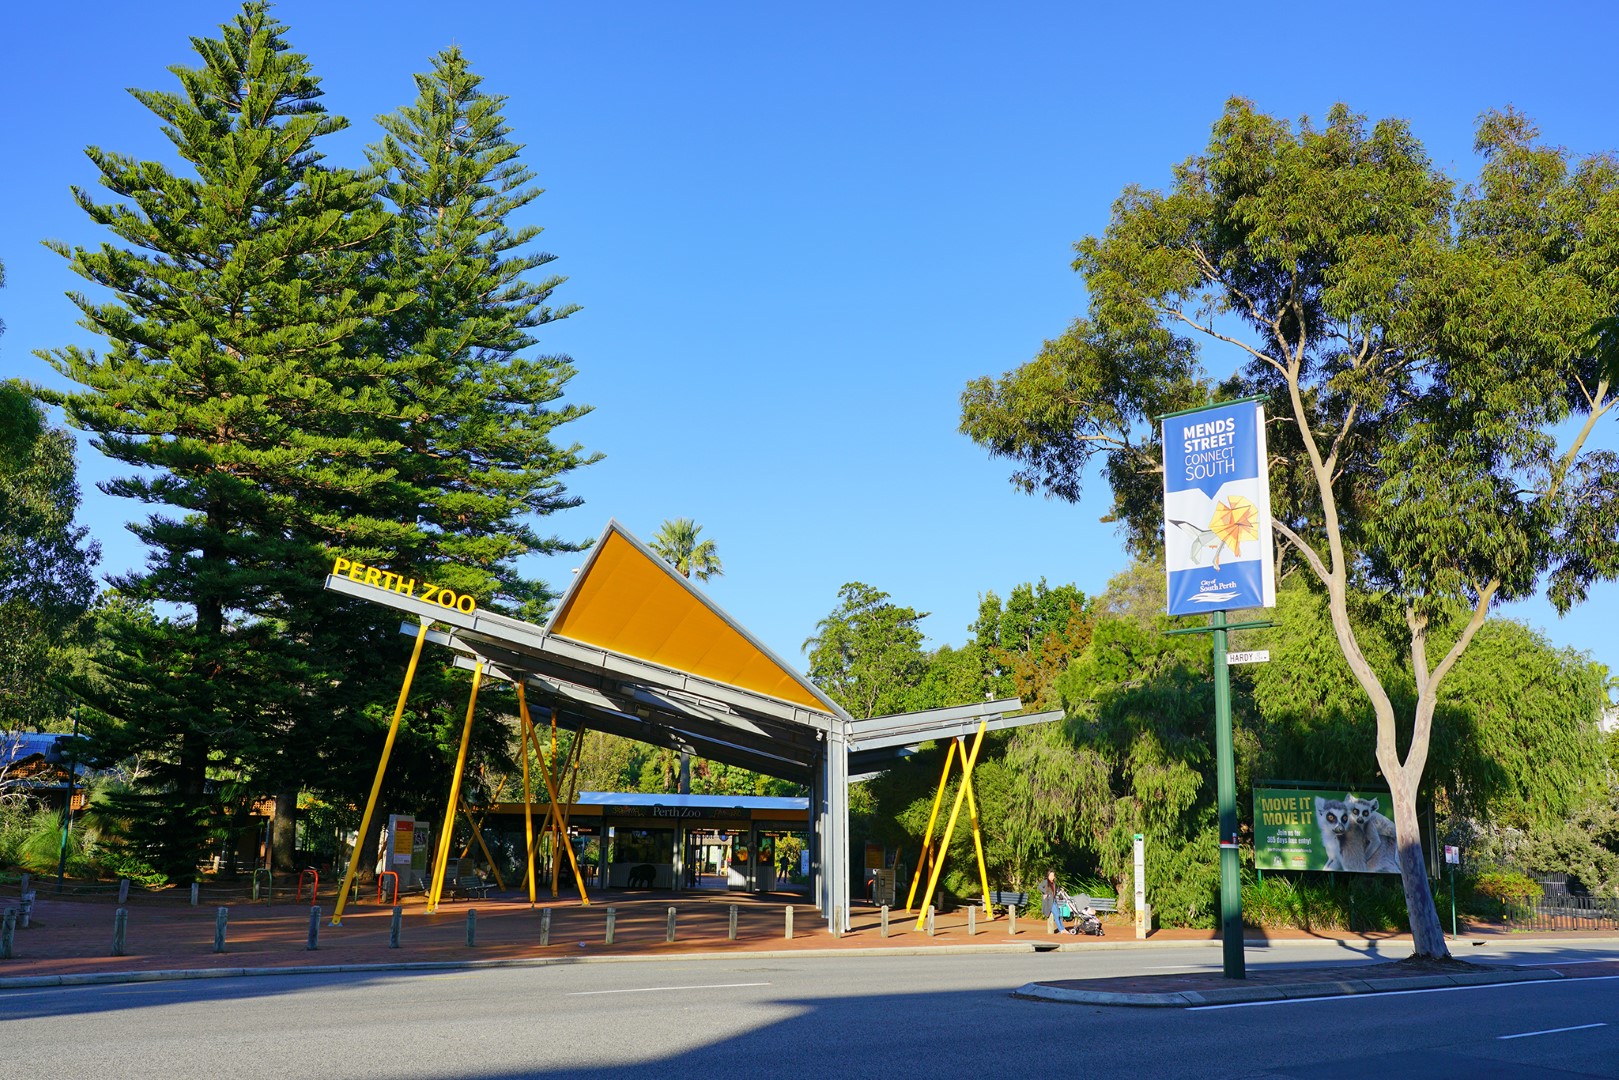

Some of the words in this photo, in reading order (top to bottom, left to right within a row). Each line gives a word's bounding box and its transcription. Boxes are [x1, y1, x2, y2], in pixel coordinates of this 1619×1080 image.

[1183, 417, 1235, 440] MENDS
[1184, 431, 1236, 453] STREET
[1185, 446, 1235, 466] CONNECT
[1185, 458, 1235, 481] SOUTH
[332, 557, 415, 597] PERTH
[419, 582, 476, 615] ZOO
[1200, 583, 1218, 592] South
[1219, 581, 1237, 590] Perth
[1230, 653, 1253, 662] HARDY
[653, 806, 680, 817] Perth
[681, 807, 701, 817] Zoo
[1261, 797, 1297, 811] MOVE
[1299, 796, 1311, 810] IT
[1263, 812, 1299, 825] MOVE
[1301, 811, 1312, 825] IT
